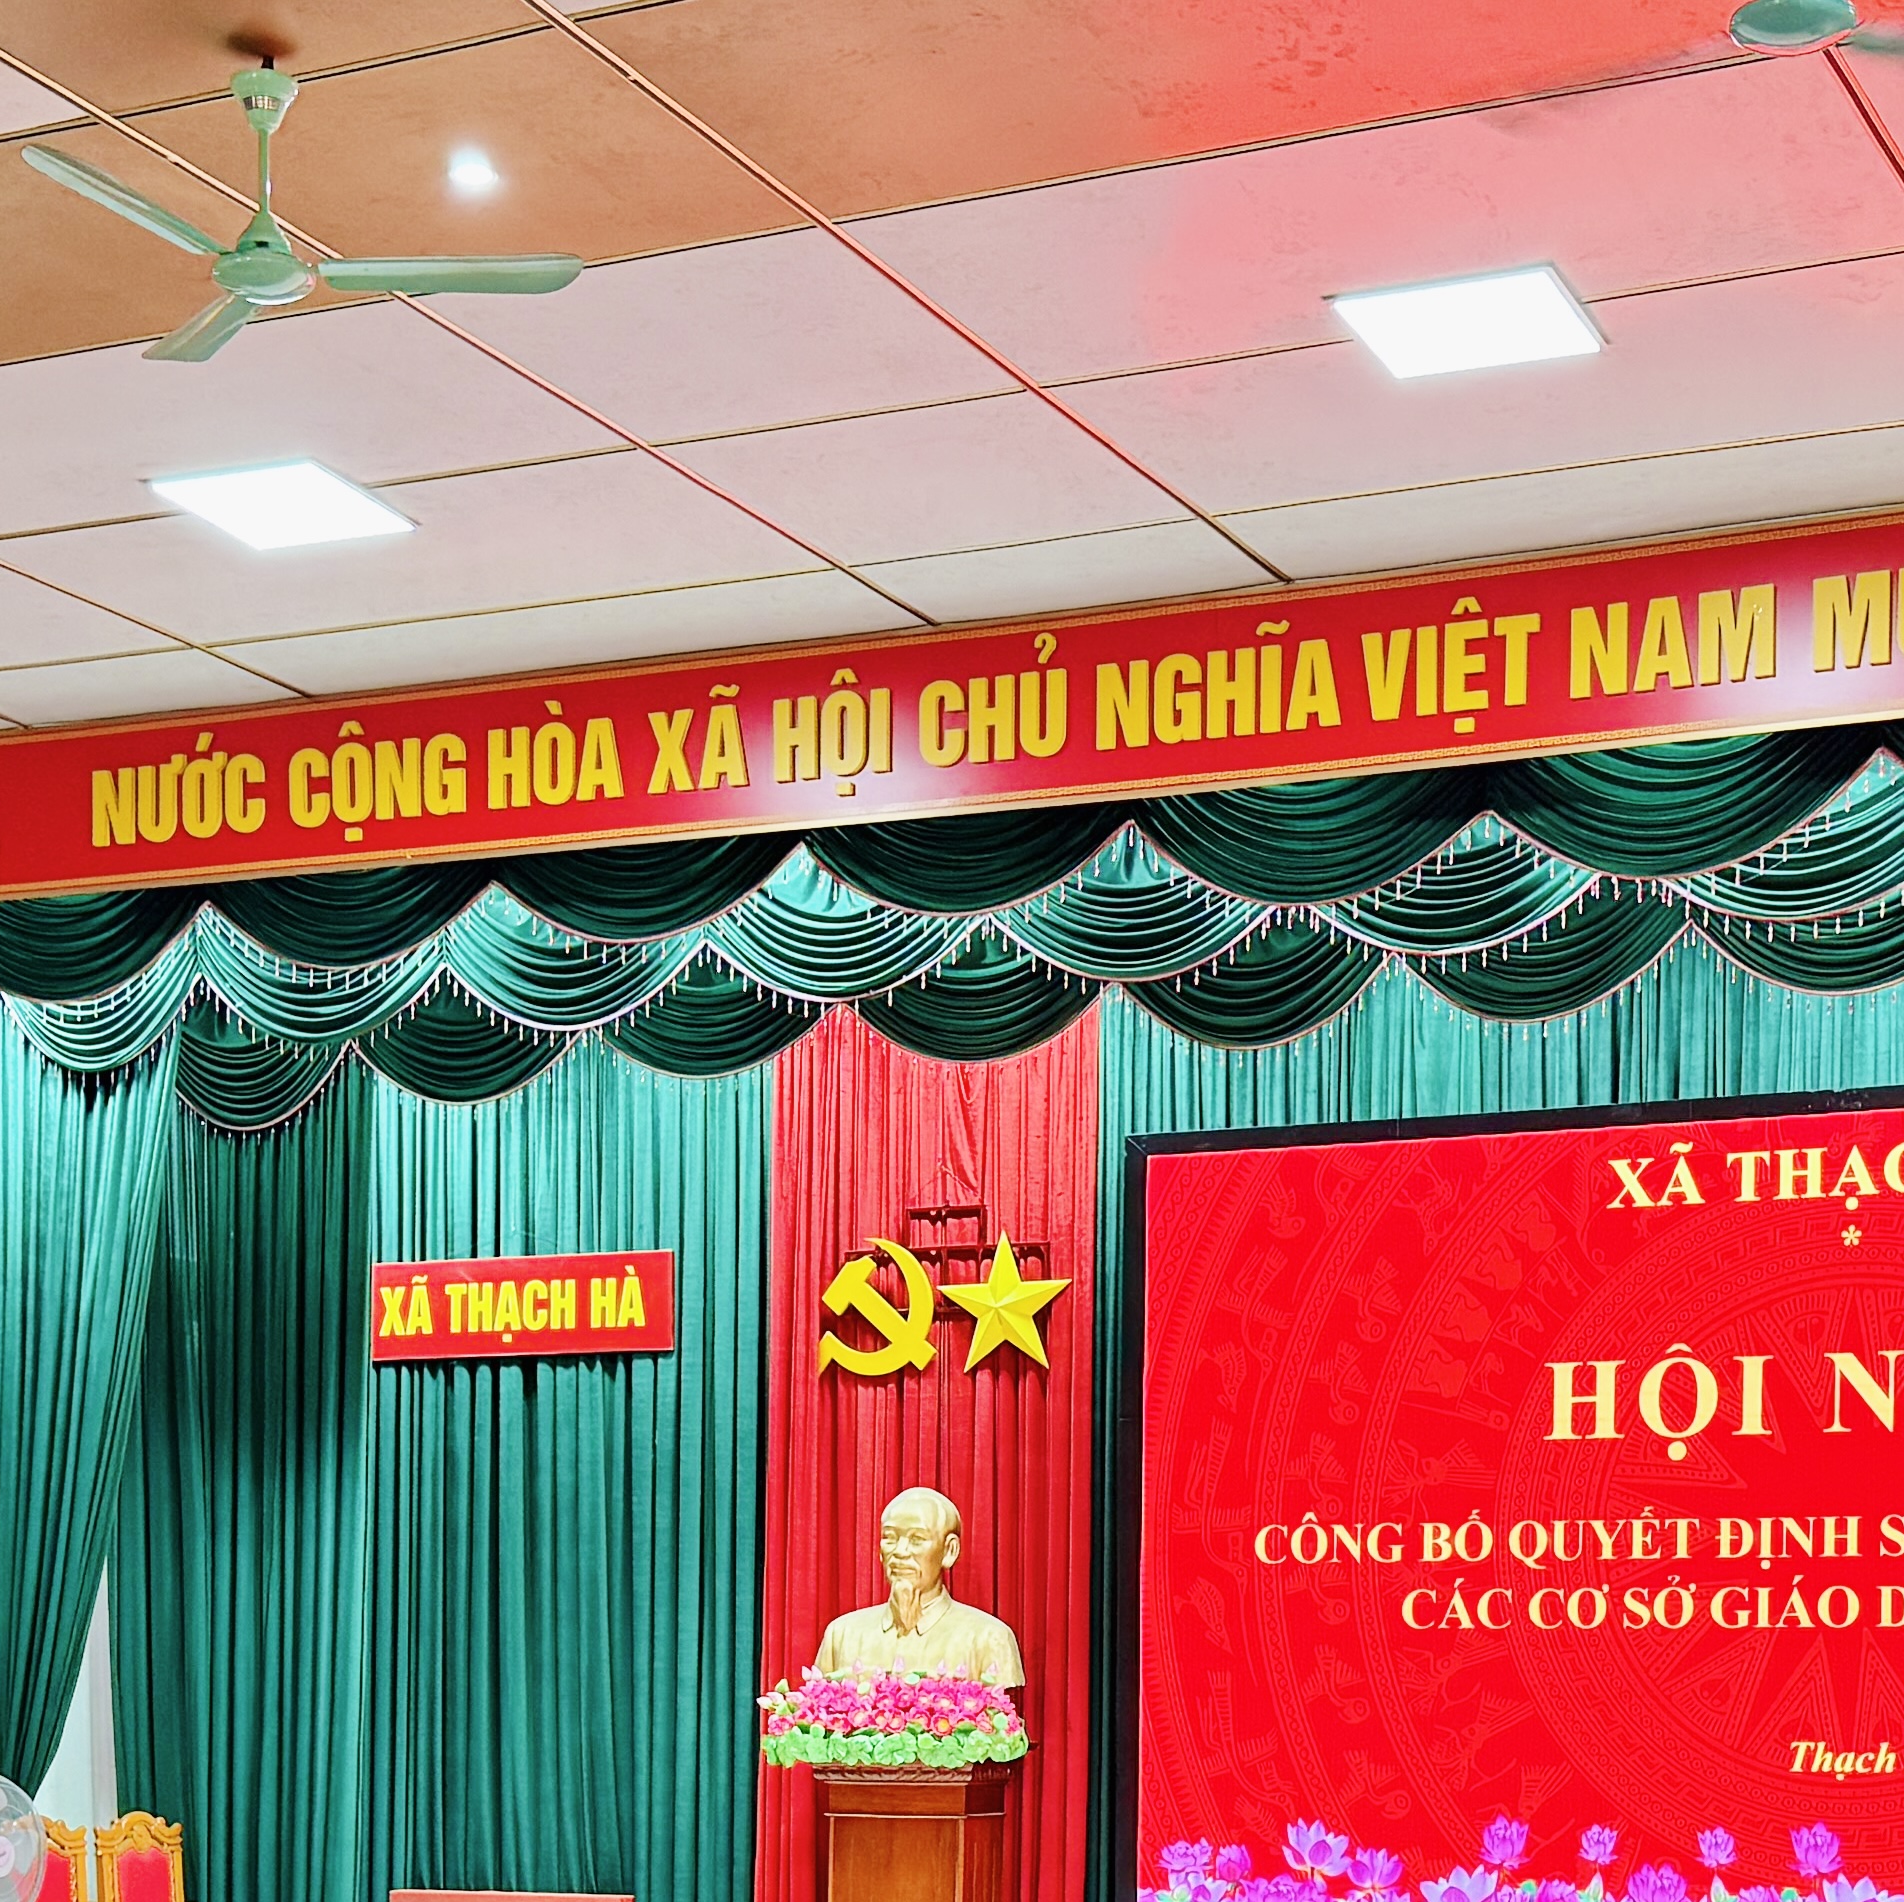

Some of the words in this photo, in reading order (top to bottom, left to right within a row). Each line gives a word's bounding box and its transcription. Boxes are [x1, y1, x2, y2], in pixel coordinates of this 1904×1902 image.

[91, 732, 266, 848] NƯỚC
[288, 723, 468, 843] CỘNG
[487, 700, 625, 810] HÒA
[647, 687, 749, 793] XÃ
[772, 668, 891, 797] HỘI
[916, 633, 1068, 763] CHỦ
[1095, 623, 1342, 751] NGHĨA
[1361, 599, 1541, 734] VIỆT
[1569, 582, 1775, 699] NAM
[1605, 1141, 1706, 1209] XÃ
[378, 1274, 434, 1337] XÃ
[444, 1278, 577, 1344] THẠCH
[590, 1264, 646, 1329] HÀ
[1543, 1342, 1773, 1461] HỘI
[1254, 1511, 1404, 1565] CÔNG
[1421, 1509, 1494, 1562] BỐ
[1508, 1506, 1700, 1570] QUYẾT
[1715, 1516, 1860, 1570] ĐỊNH
[1401, 1577, 1513, 1630] CÁC
[1528, 1583, 1610, 1630] CƠ
[1623, 1575, 1697, 1630] SỞ
[1710, 1574, 1860, 1629] GIÁO
[1790, 1741, 1897, 1781] Thạch
